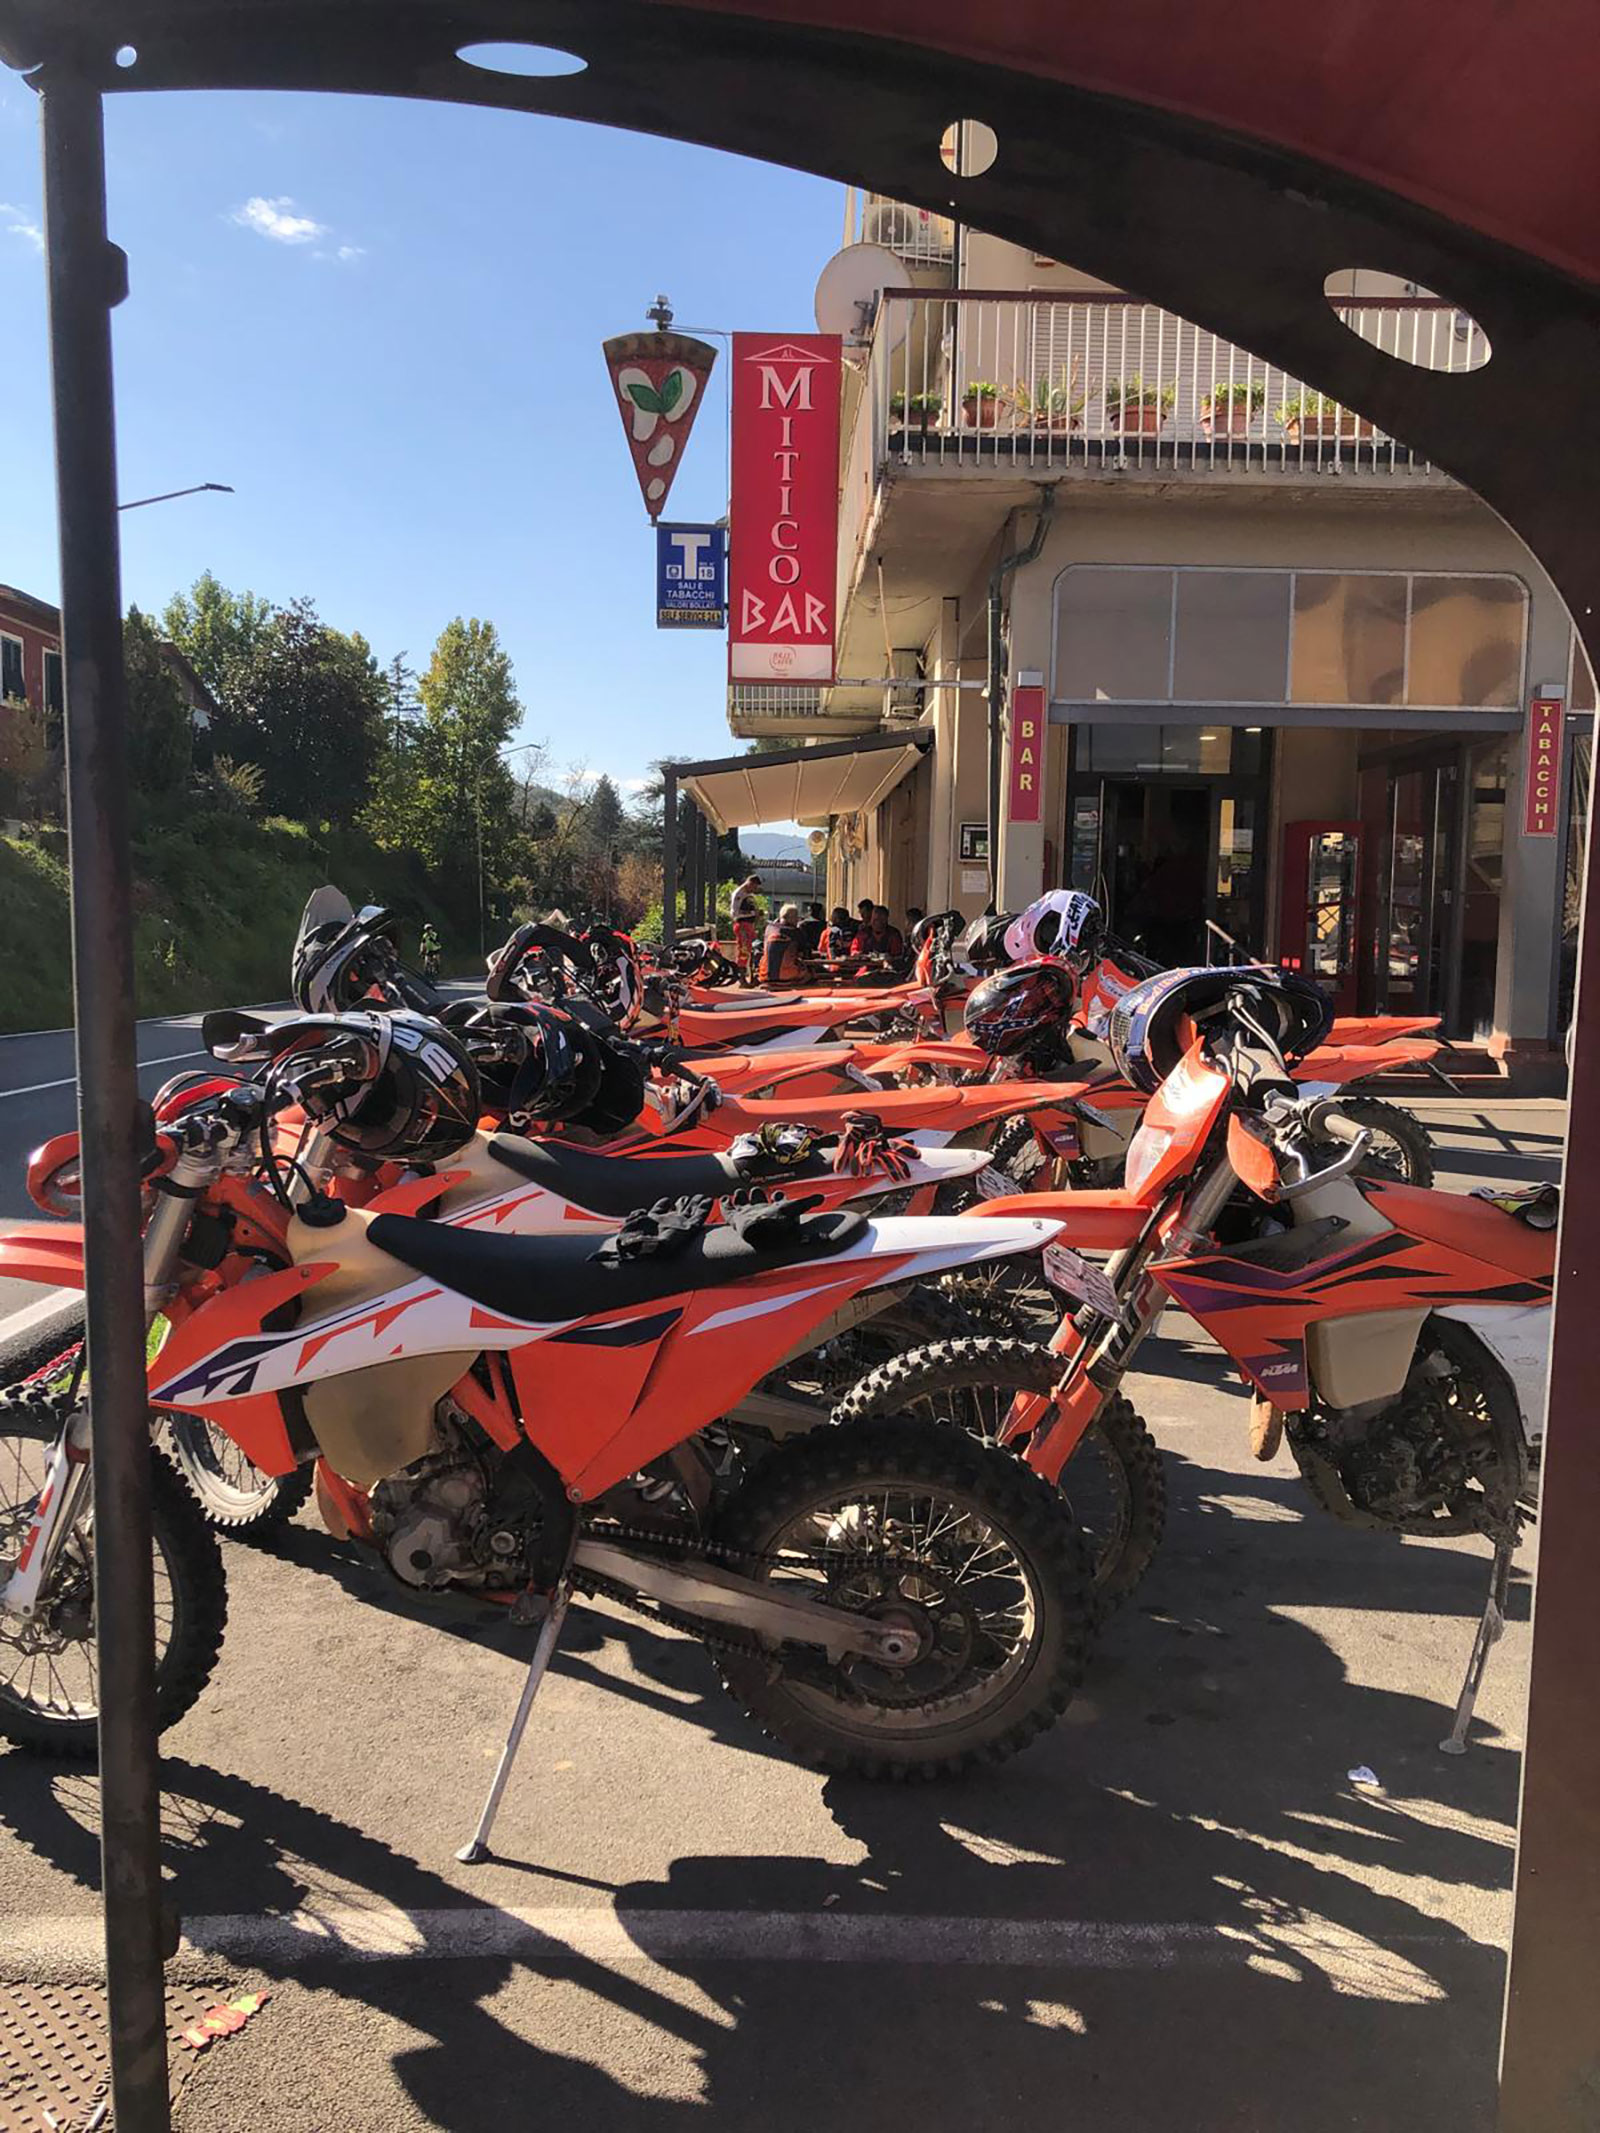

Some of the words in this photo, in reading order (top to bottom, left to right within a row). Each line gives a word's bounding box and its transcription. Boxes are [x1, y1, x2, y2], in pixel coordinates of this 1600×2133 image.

[758, 365, 817, 586] MITICO
[671, 533, 711, 580] T
[667, 590, 715, 599] TABACCHI
[678, 582, 696, 590] SALI
[698, 582, 704, 590] E
[742, 587, 827, 636] BAR
[1019, 720, 1035, 791] BAR
[1535, 705, 1553, 830] TABACCHI
[1261, 1363, 1299, 1377] KTM
